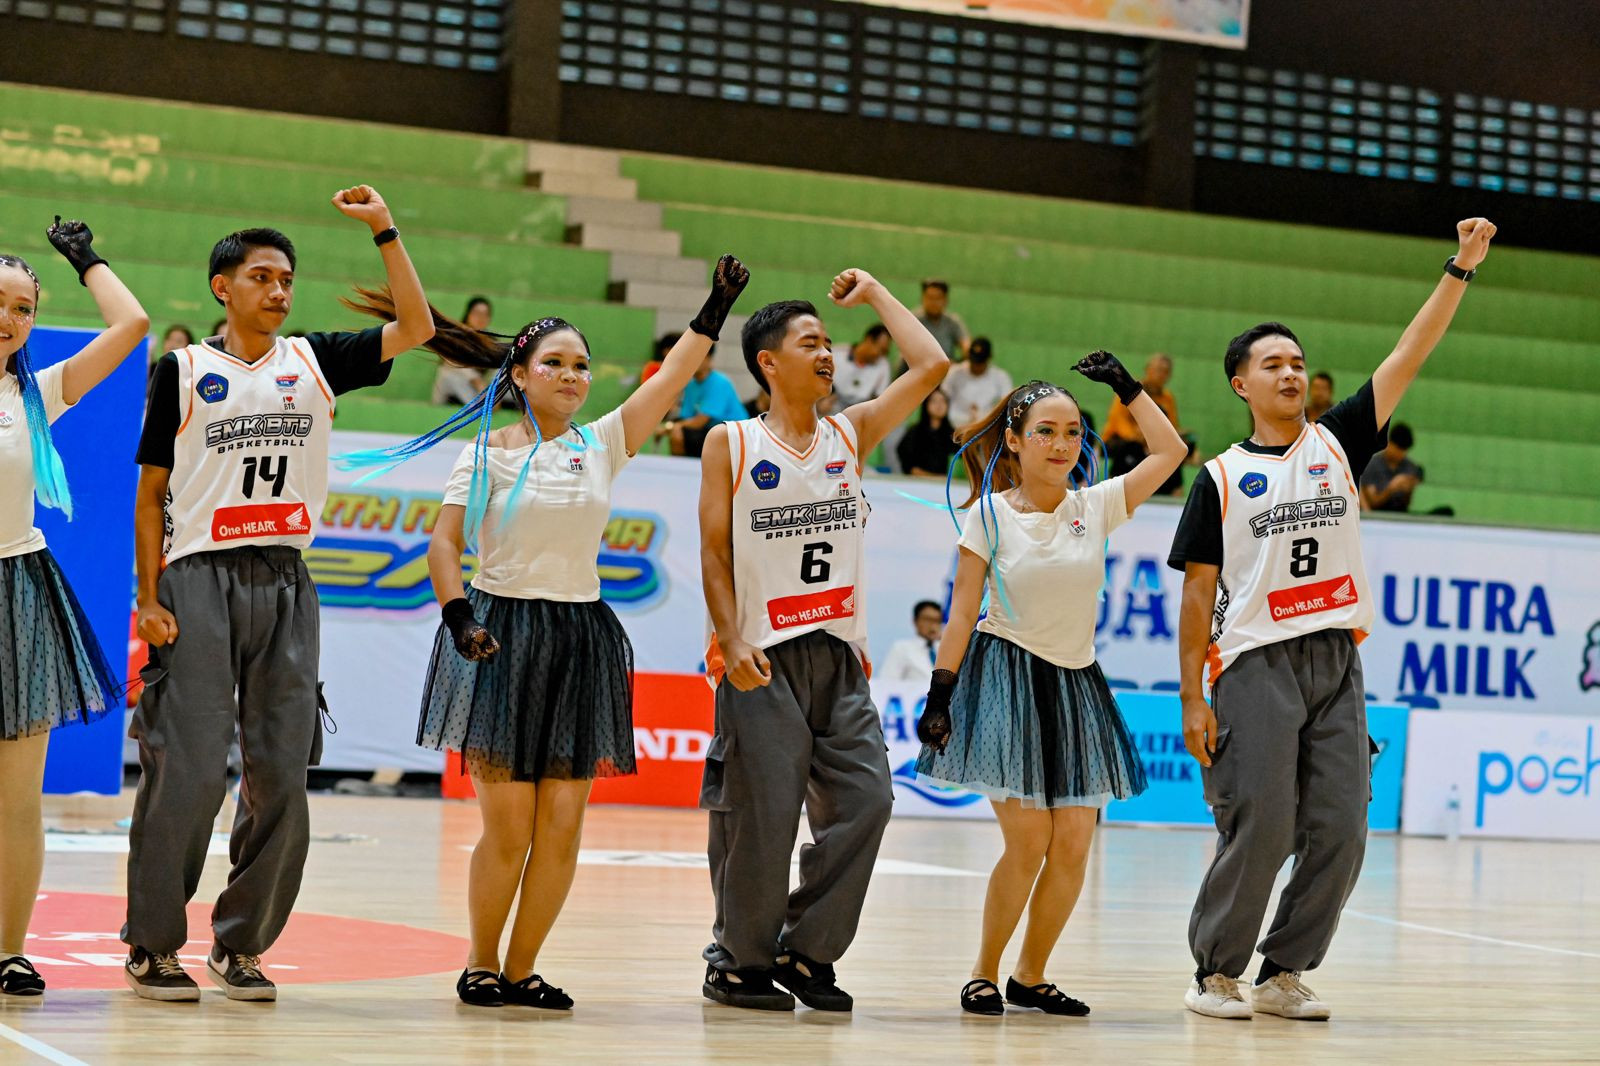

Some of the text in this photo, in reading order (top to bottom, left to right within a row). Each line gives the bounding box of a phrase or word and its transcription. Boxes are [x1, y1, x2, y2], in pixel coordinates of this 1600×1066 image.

[283, 402, 296, 411] BTB
[206, 414, 313, 448] SMK BTB
[217, 439, 305, 455] BASKETBALL
[242, 455, 288, 499] 14
[1319, 488, 1331, 496] BTB
[219, 524, 241, 537] One
[751, 504, 812, 532] SMK
[765, 522, 857, 540] BASKETBALL
[1249, 496, 1347, 538] SMK BTB
[800, 541, 833, 585] 6
[1290, 537, 1319, 578] 8
[1274, 605, 1296, 618] One
[1383, 574, 1556, 636] ULTRA
[776, 614, 798, 625] One
[1398, 641, 1537, 699] MILK
